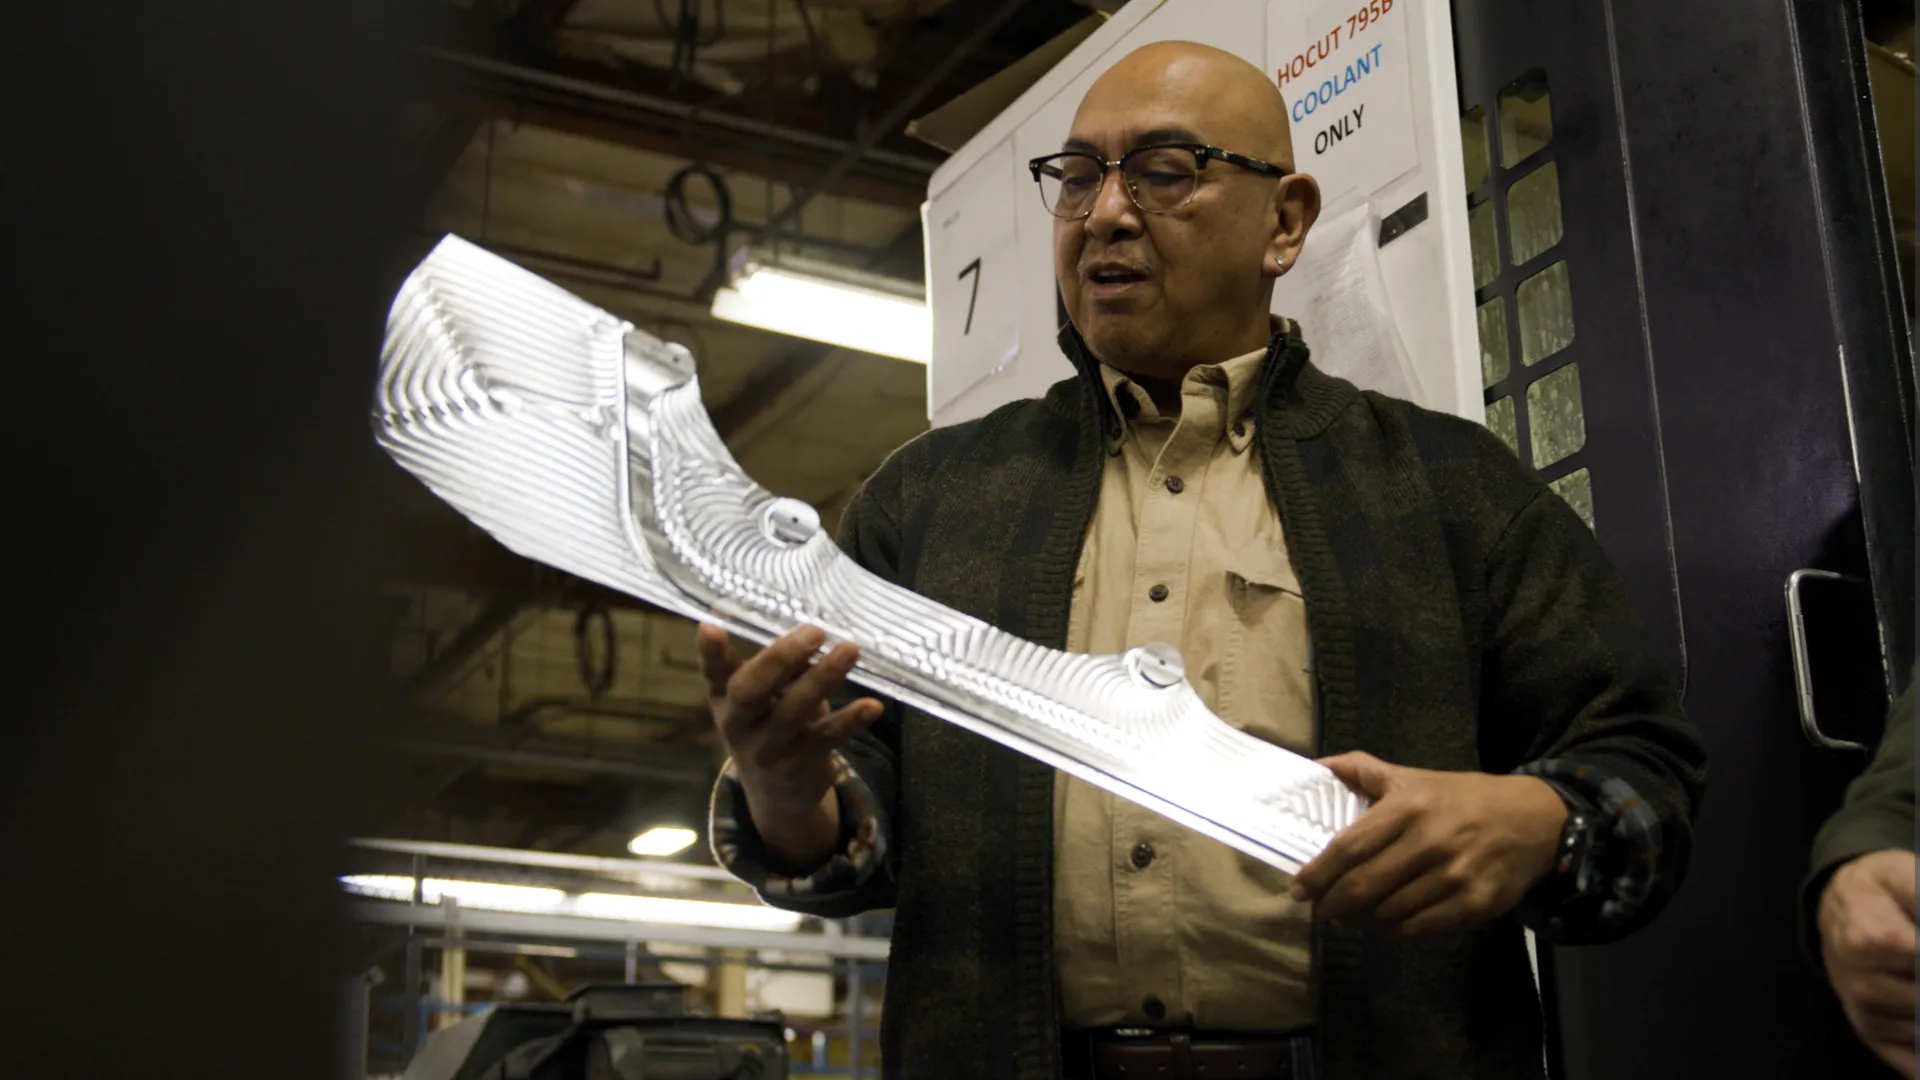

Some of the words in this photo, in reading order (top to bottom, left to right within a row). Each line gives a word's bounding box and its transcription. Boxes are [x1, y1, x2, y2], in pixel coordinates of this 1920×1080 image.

[1277, 26, 1342, 88] HOCUT
[1292, 44, 1382, 123] COOLANT
[1314, 104, 1364, 155] ONLY
[957, 256, 982, 336] 7
